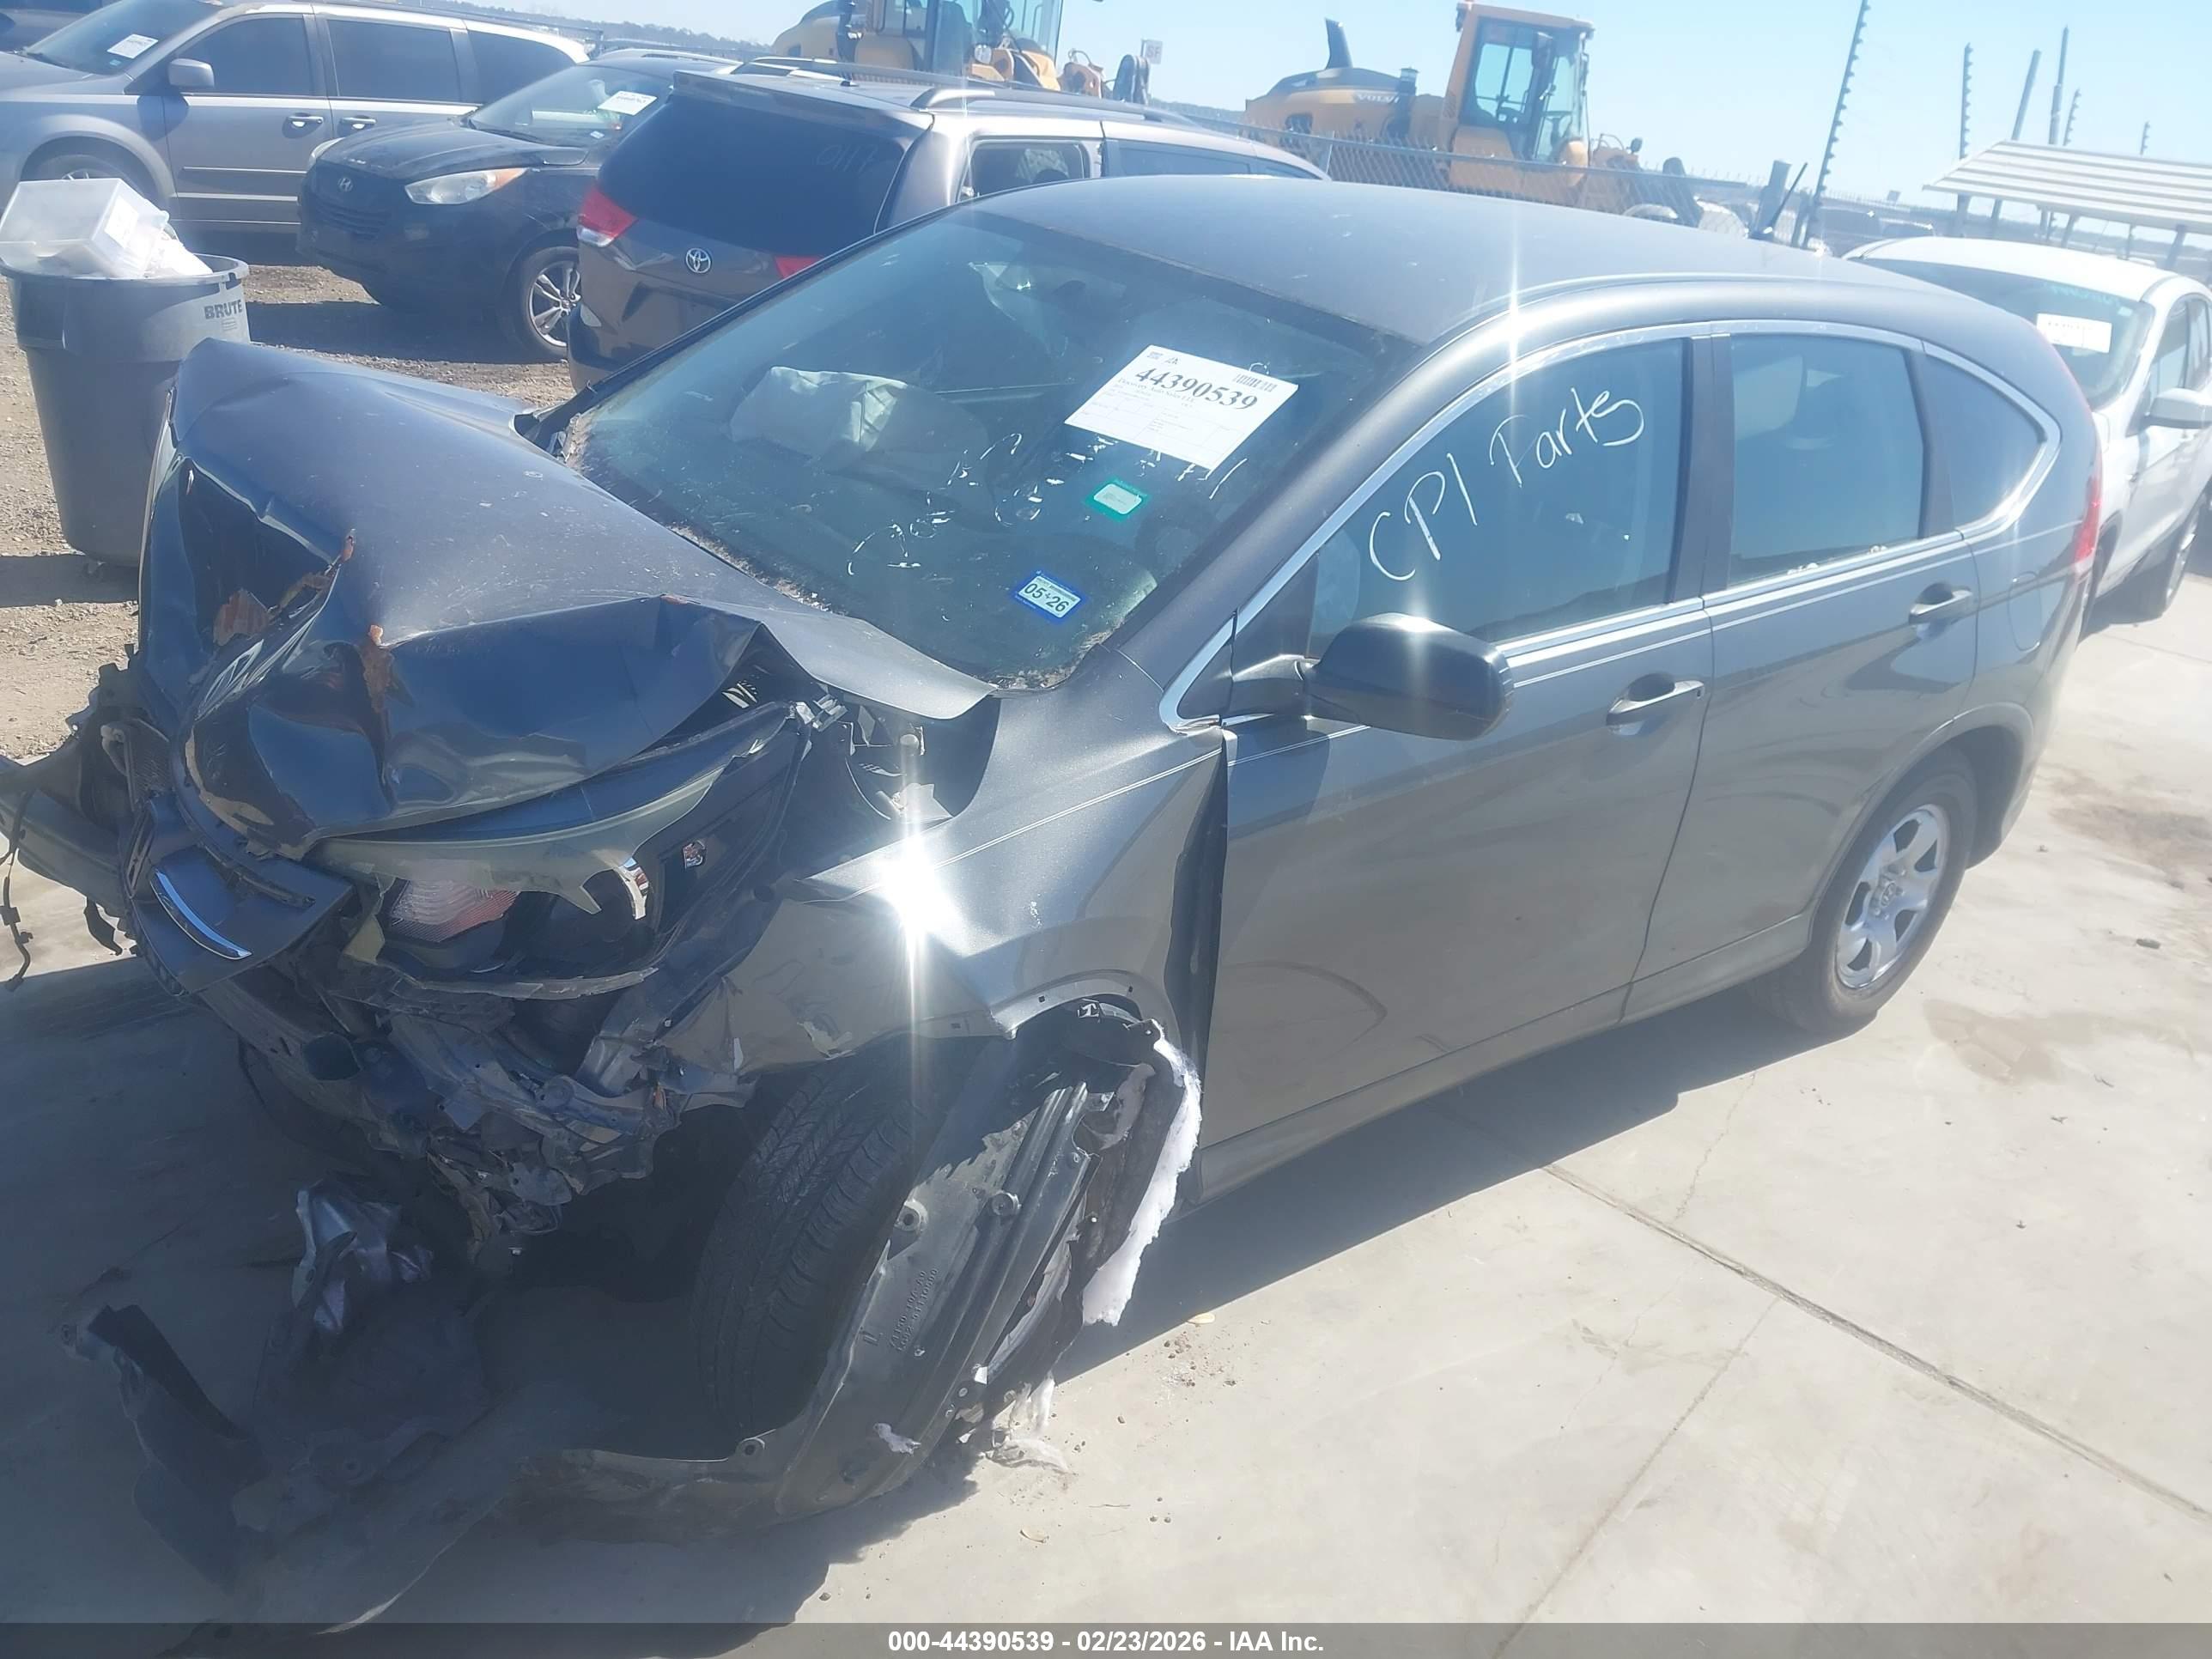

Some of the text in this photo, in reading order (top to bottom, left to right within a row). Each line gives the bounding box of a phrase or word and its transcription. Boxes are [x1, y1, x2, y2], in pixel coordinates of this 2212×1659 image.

[204, 299, 243, 319] BRUTE
[1134, 368, 1258, 410] 44390539
[1490, 387, 1644, 489] Parts
